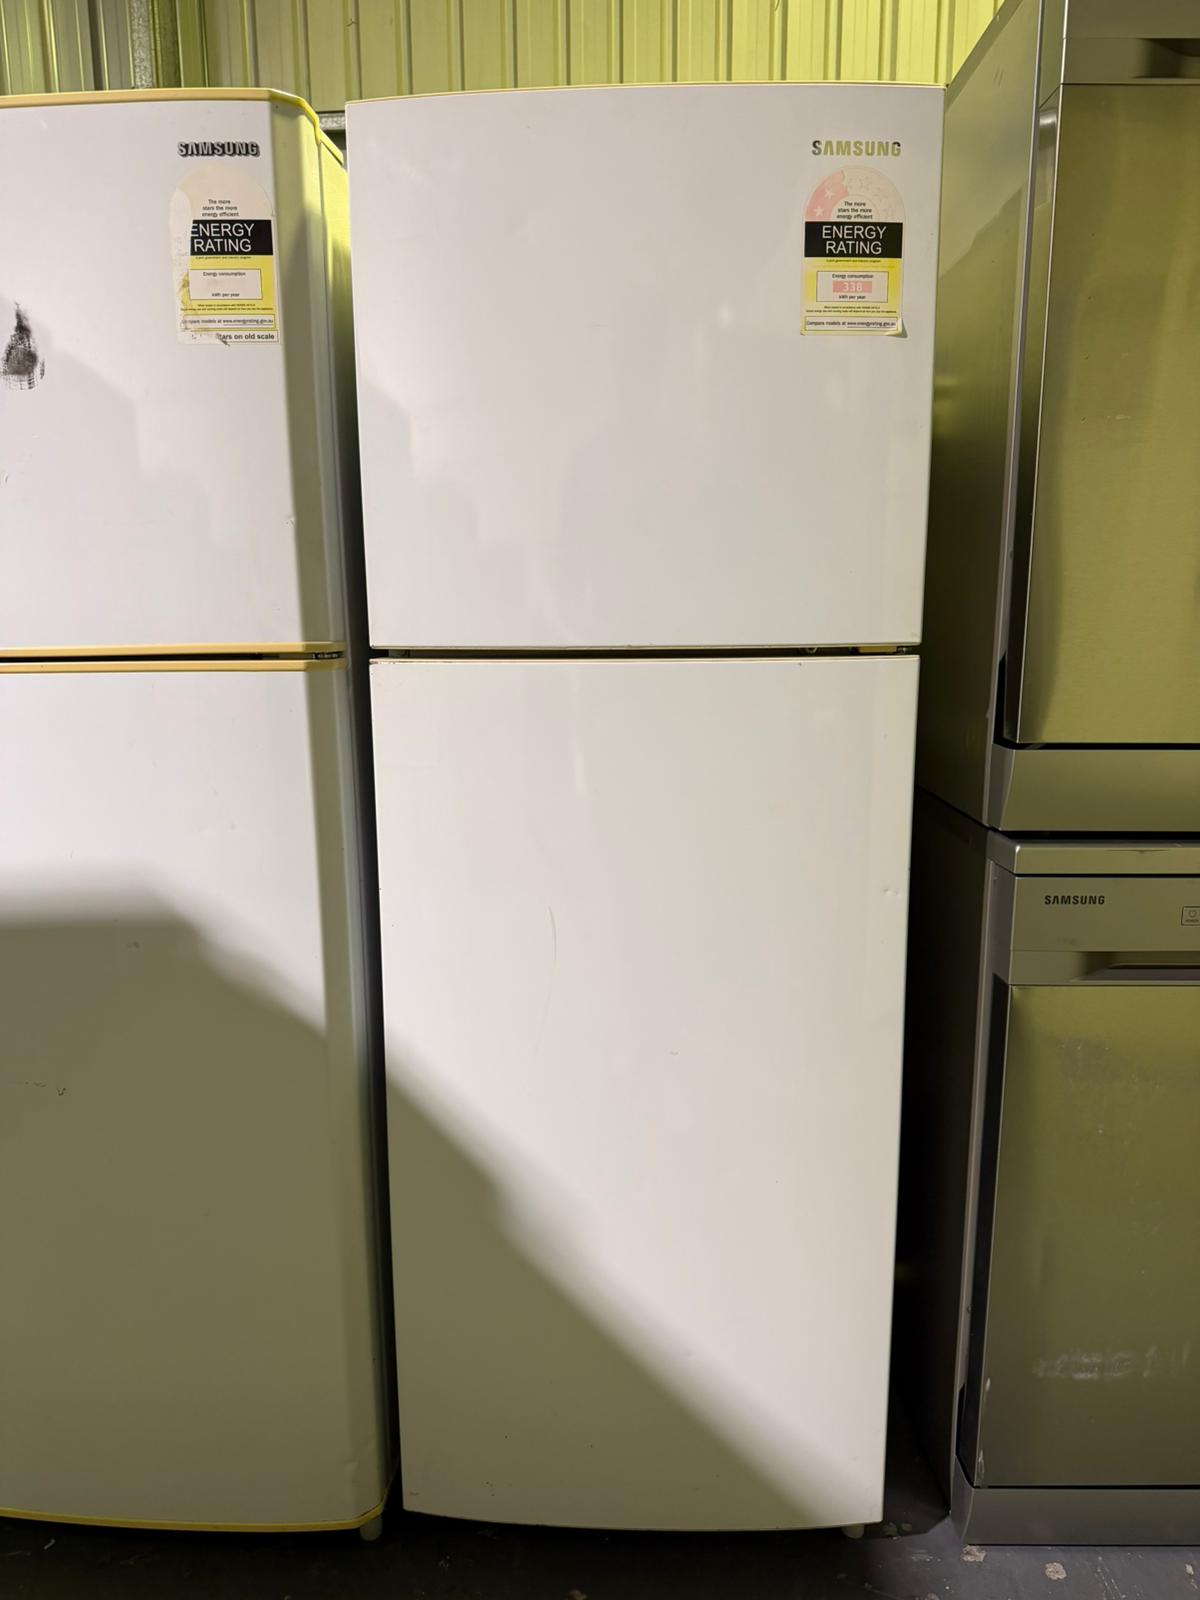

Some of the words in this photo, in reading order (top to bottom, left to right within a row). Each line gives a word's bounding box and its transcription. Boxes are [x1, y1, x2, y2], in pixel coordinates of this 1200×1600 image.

[177, 141, 260, 157] SAMSUNG
[812, 140, 901, 157] SAMSUNG
[191, 223, 255, 237] ENERGY
[822, 225, 887, 240] ENERGY
[194, 239, 252, 252] RATING
[825, 240, 882, 255] RATING
[1044, 895, 1105, 905] SAMSUNG
